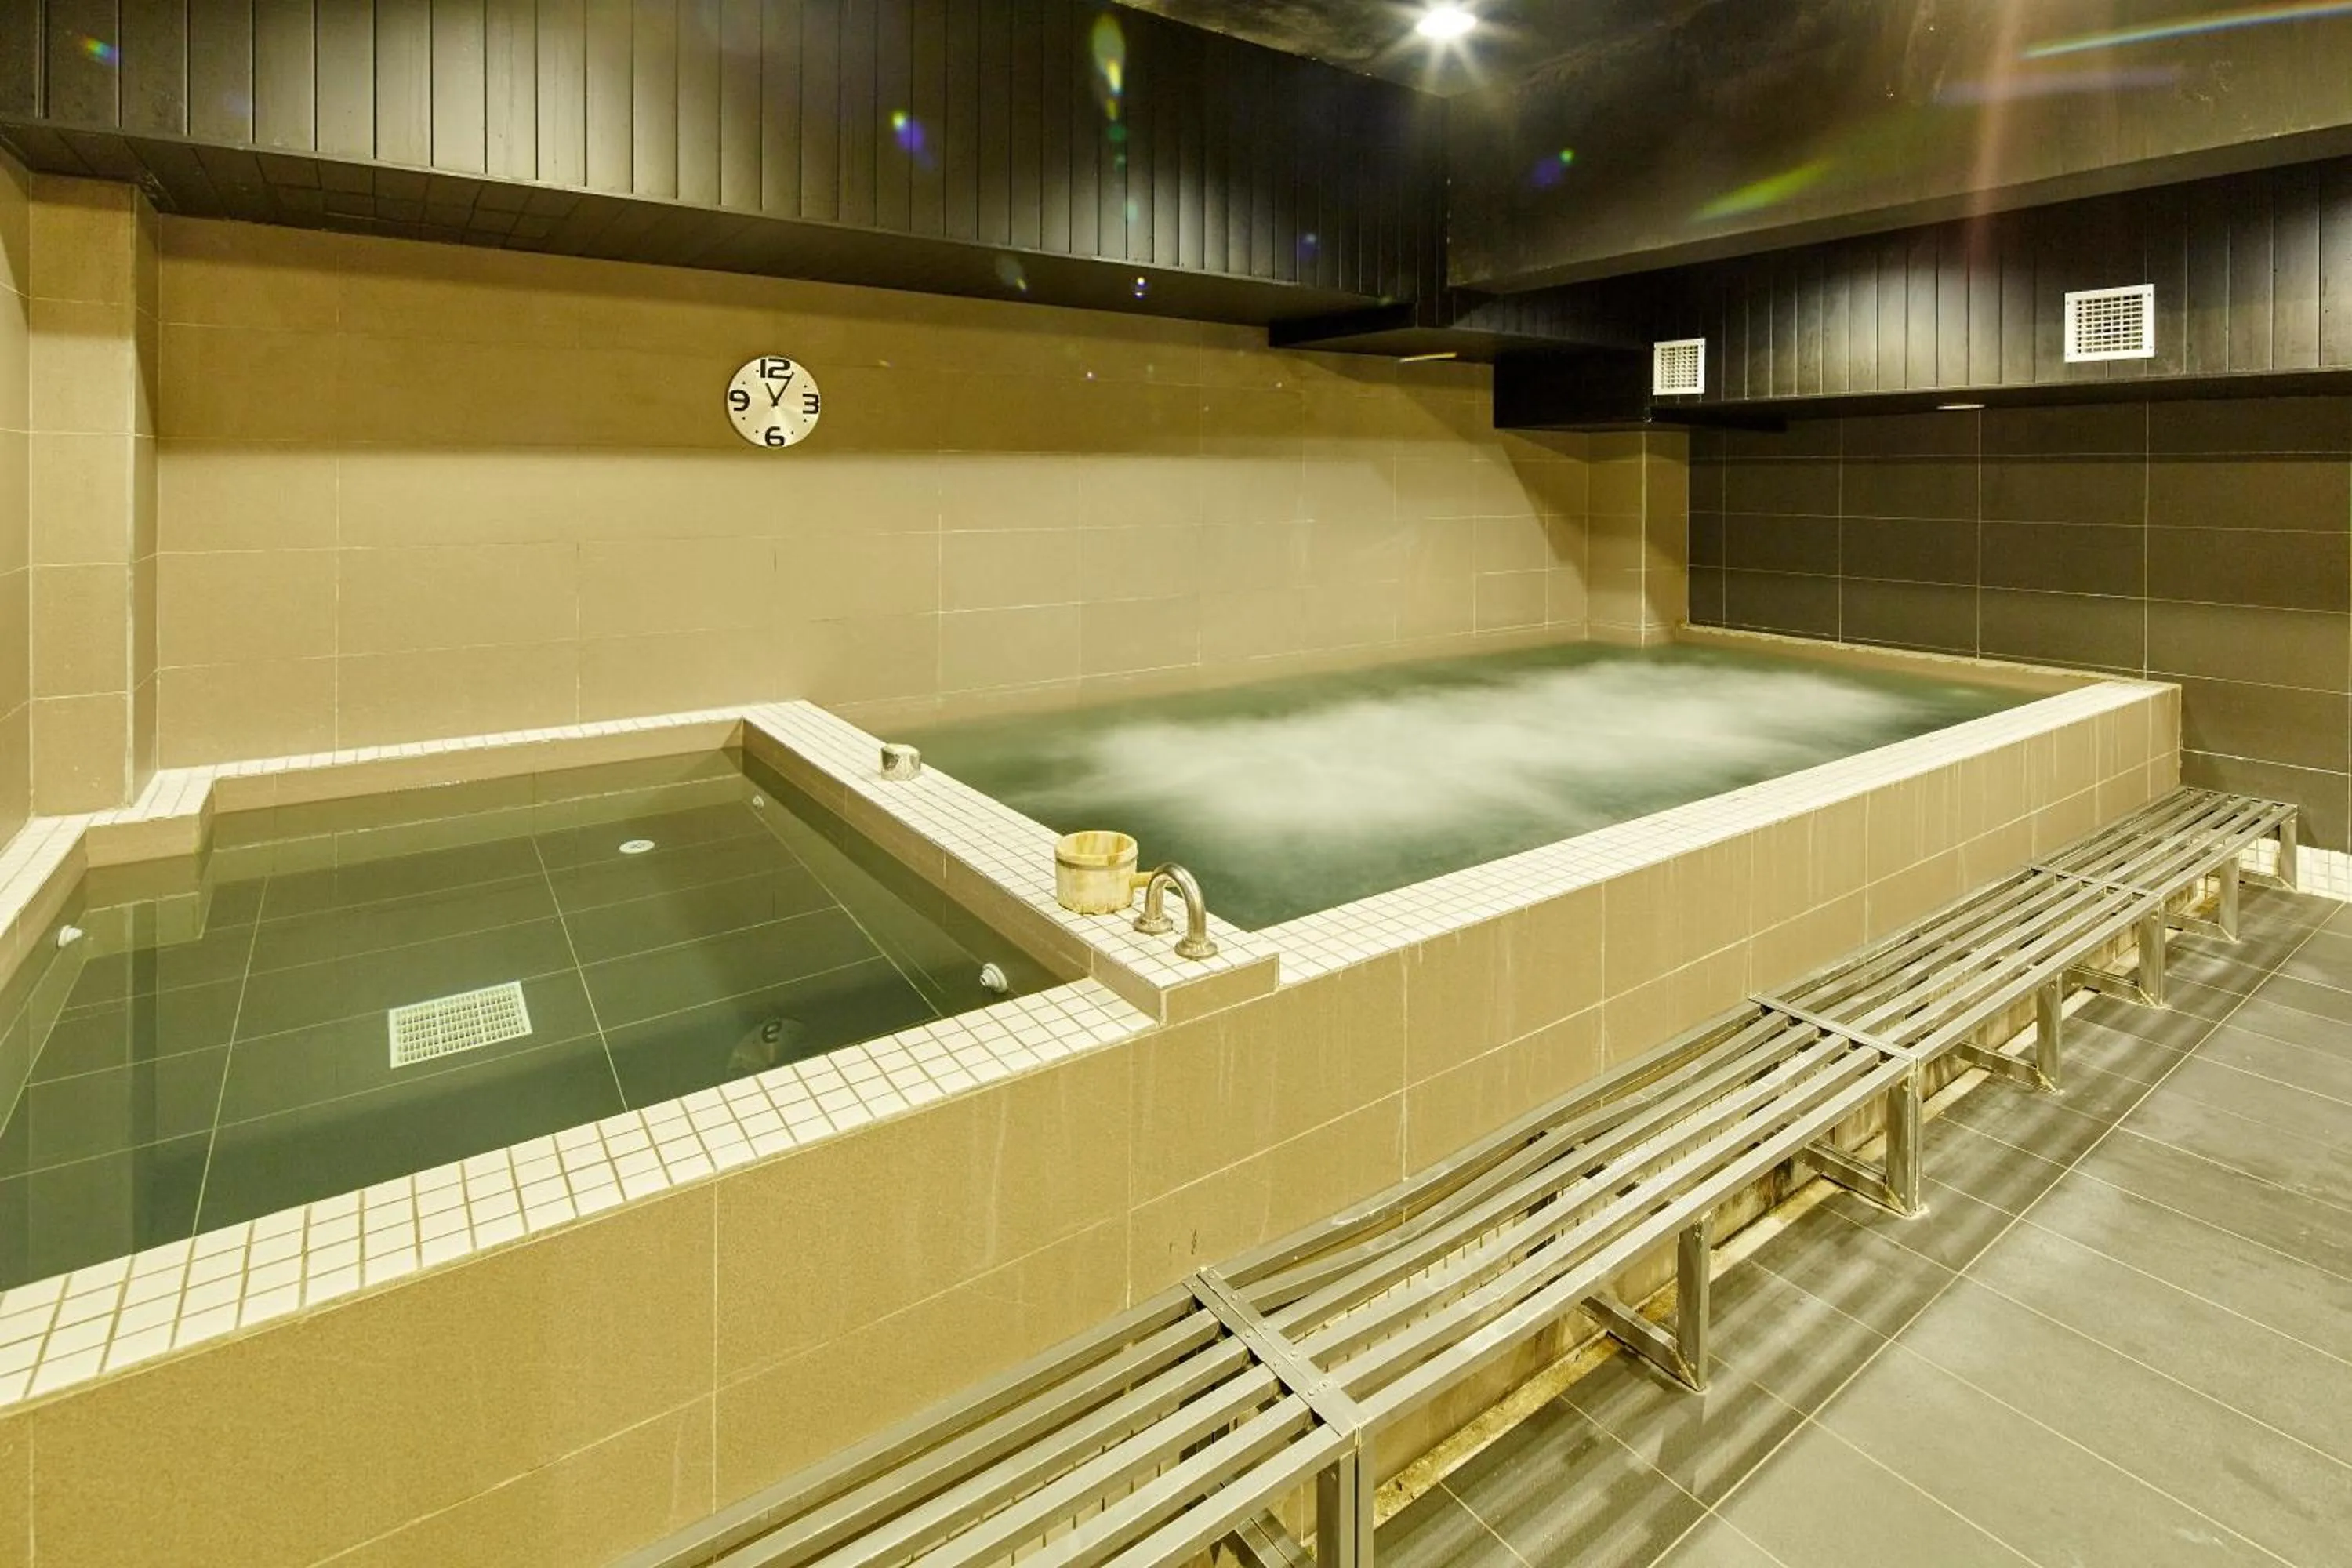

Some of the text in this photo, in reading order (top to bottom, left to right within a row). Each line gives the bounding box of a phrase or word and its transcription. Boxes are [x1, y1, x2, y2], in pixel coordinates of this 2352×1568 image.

[760, 358, 791, 379] 12
[728, 390, 750, 412] 9
[802, 393, 819, 415] 3
[764, 426, 785, 447] 6
